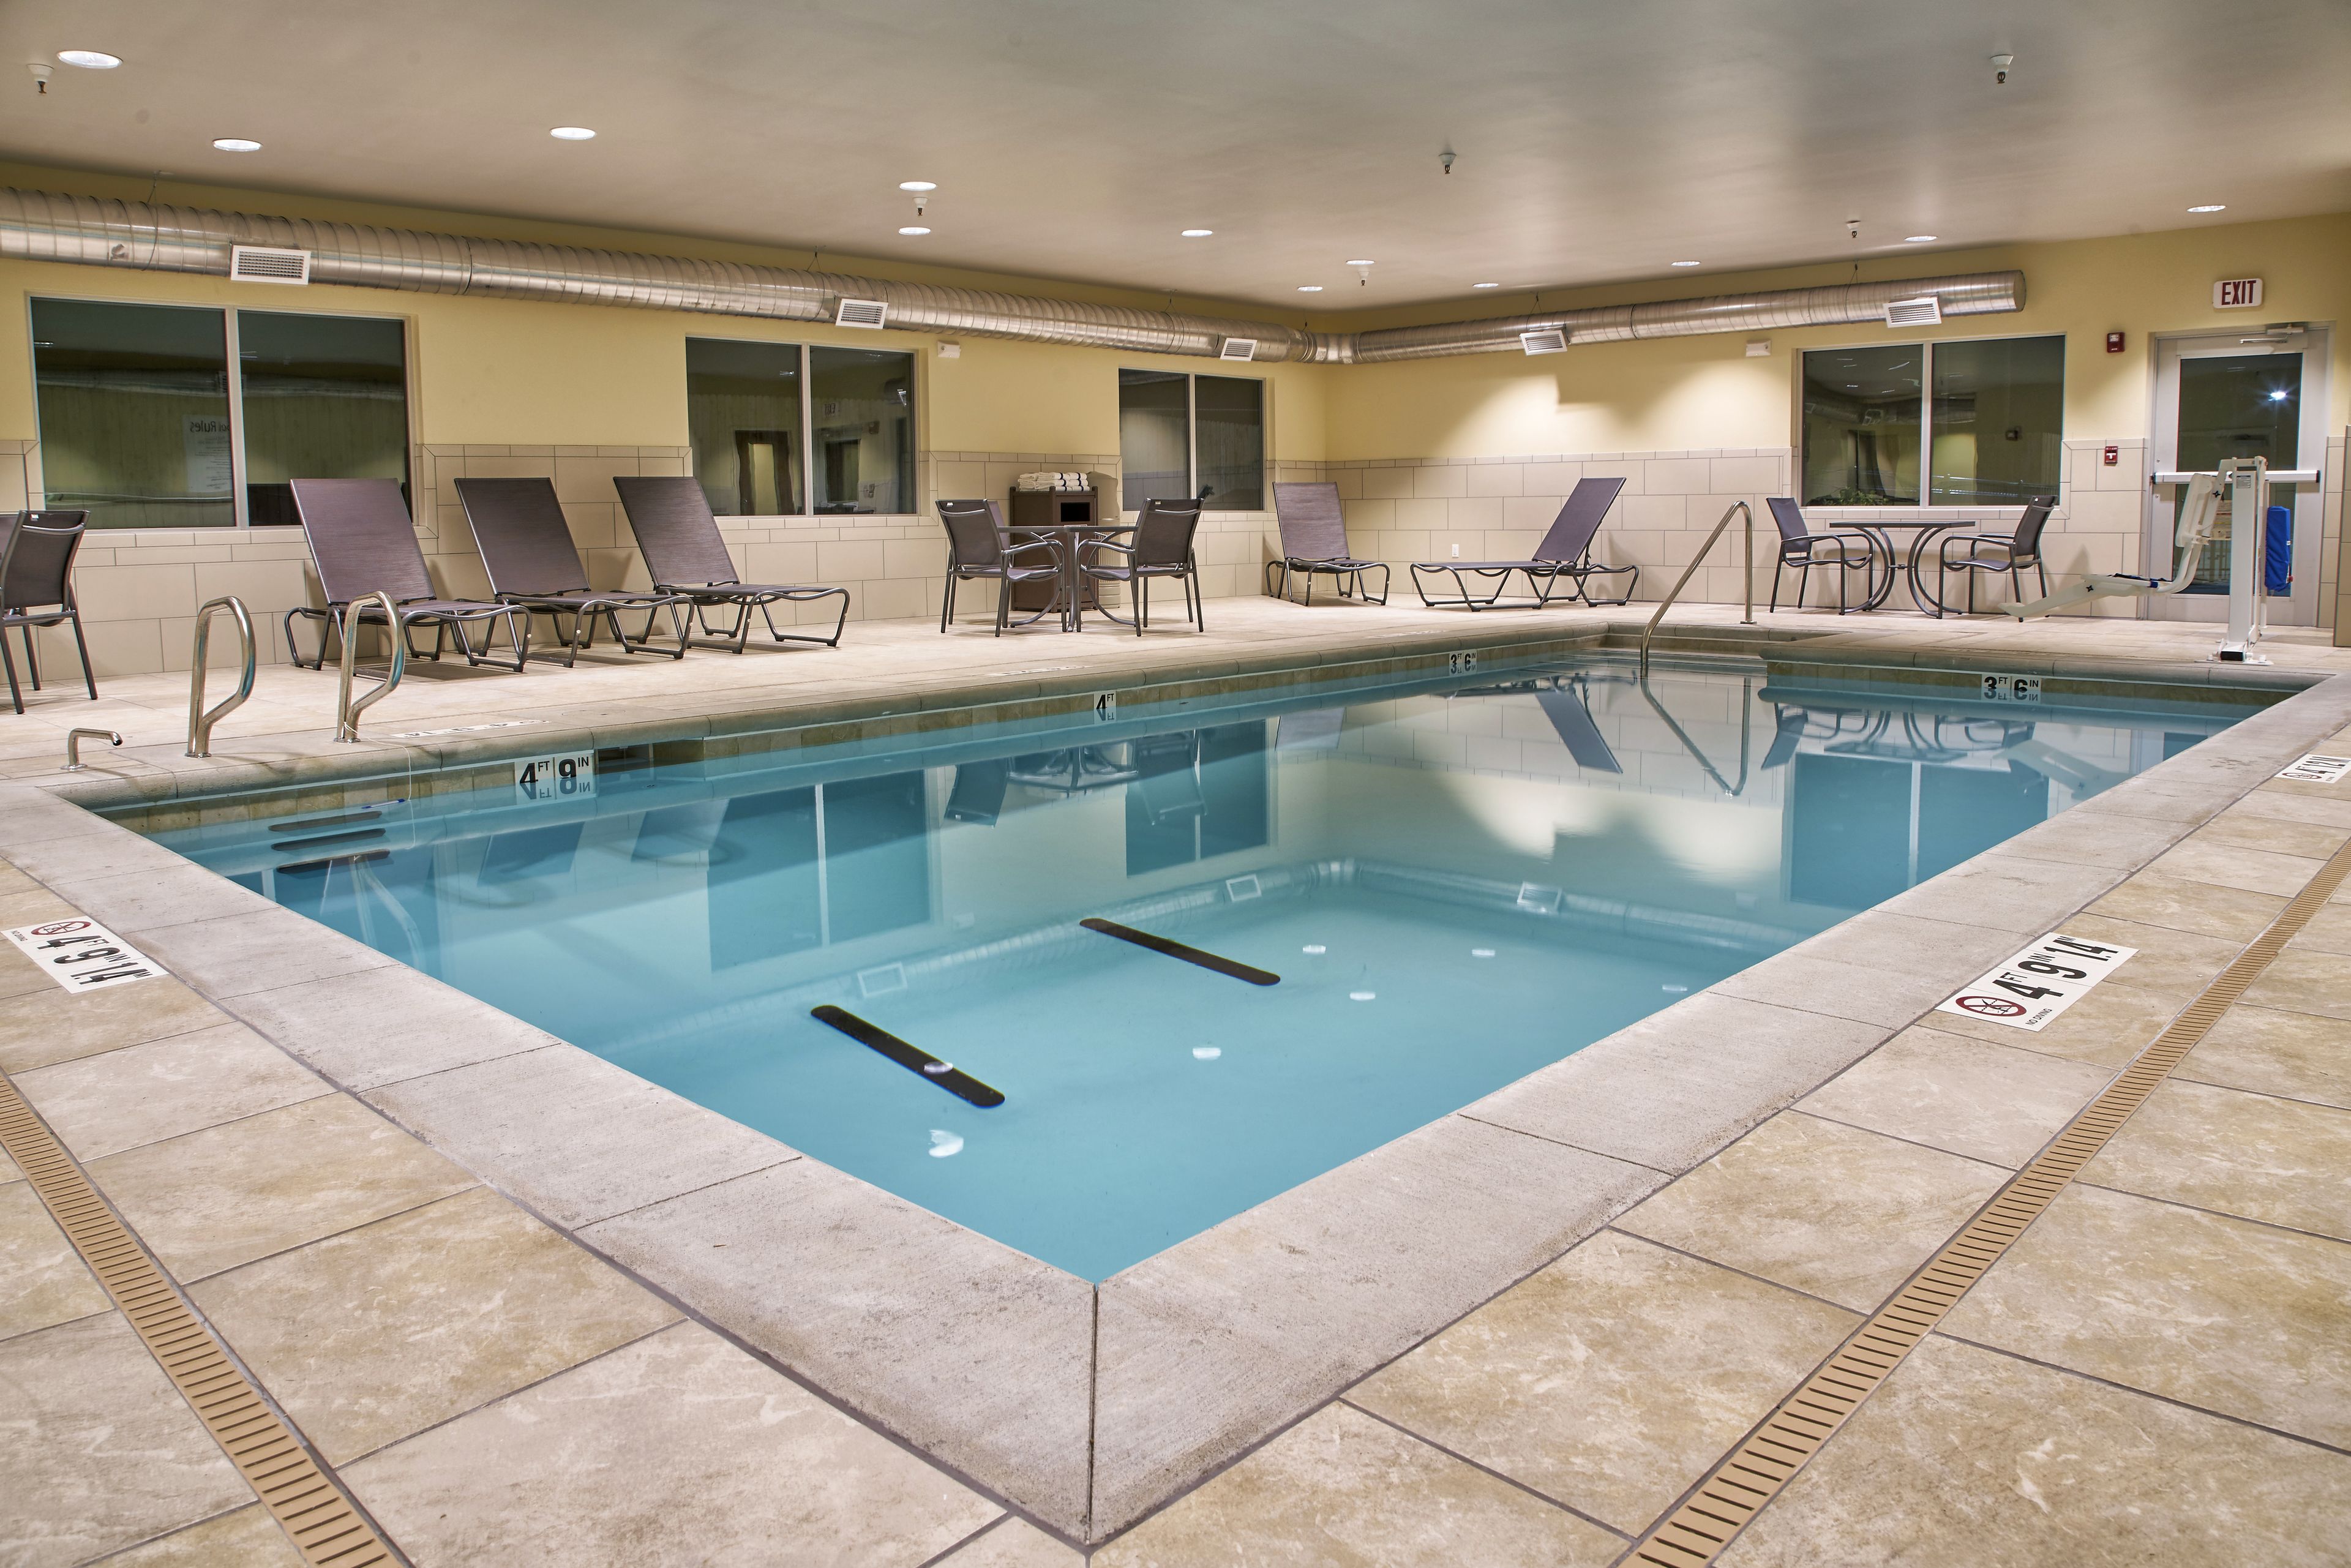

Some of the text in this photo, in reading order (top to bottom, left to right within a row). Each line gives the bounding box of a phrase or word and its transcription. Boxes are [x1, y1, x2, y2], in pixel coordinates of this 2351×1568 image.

[2221, 280, 2257, 306] EXIT
[1096, 693, 1114, 709] 4 FT
[520, 756, 589, 784] 4 FT 9 IN
[37, 936, 102, 950] 4
[53, 947, 121, 964] 9
[104, 953, 130, 962] IN
[2028, 953, 2056, 962] IN
[2000, 972, 2028, 983] FT
[2018, 960, 2087, 979] 9
[1992, 979, 2064, 1000] 4
[2033, 1008, 2053, 1020] DIVING
